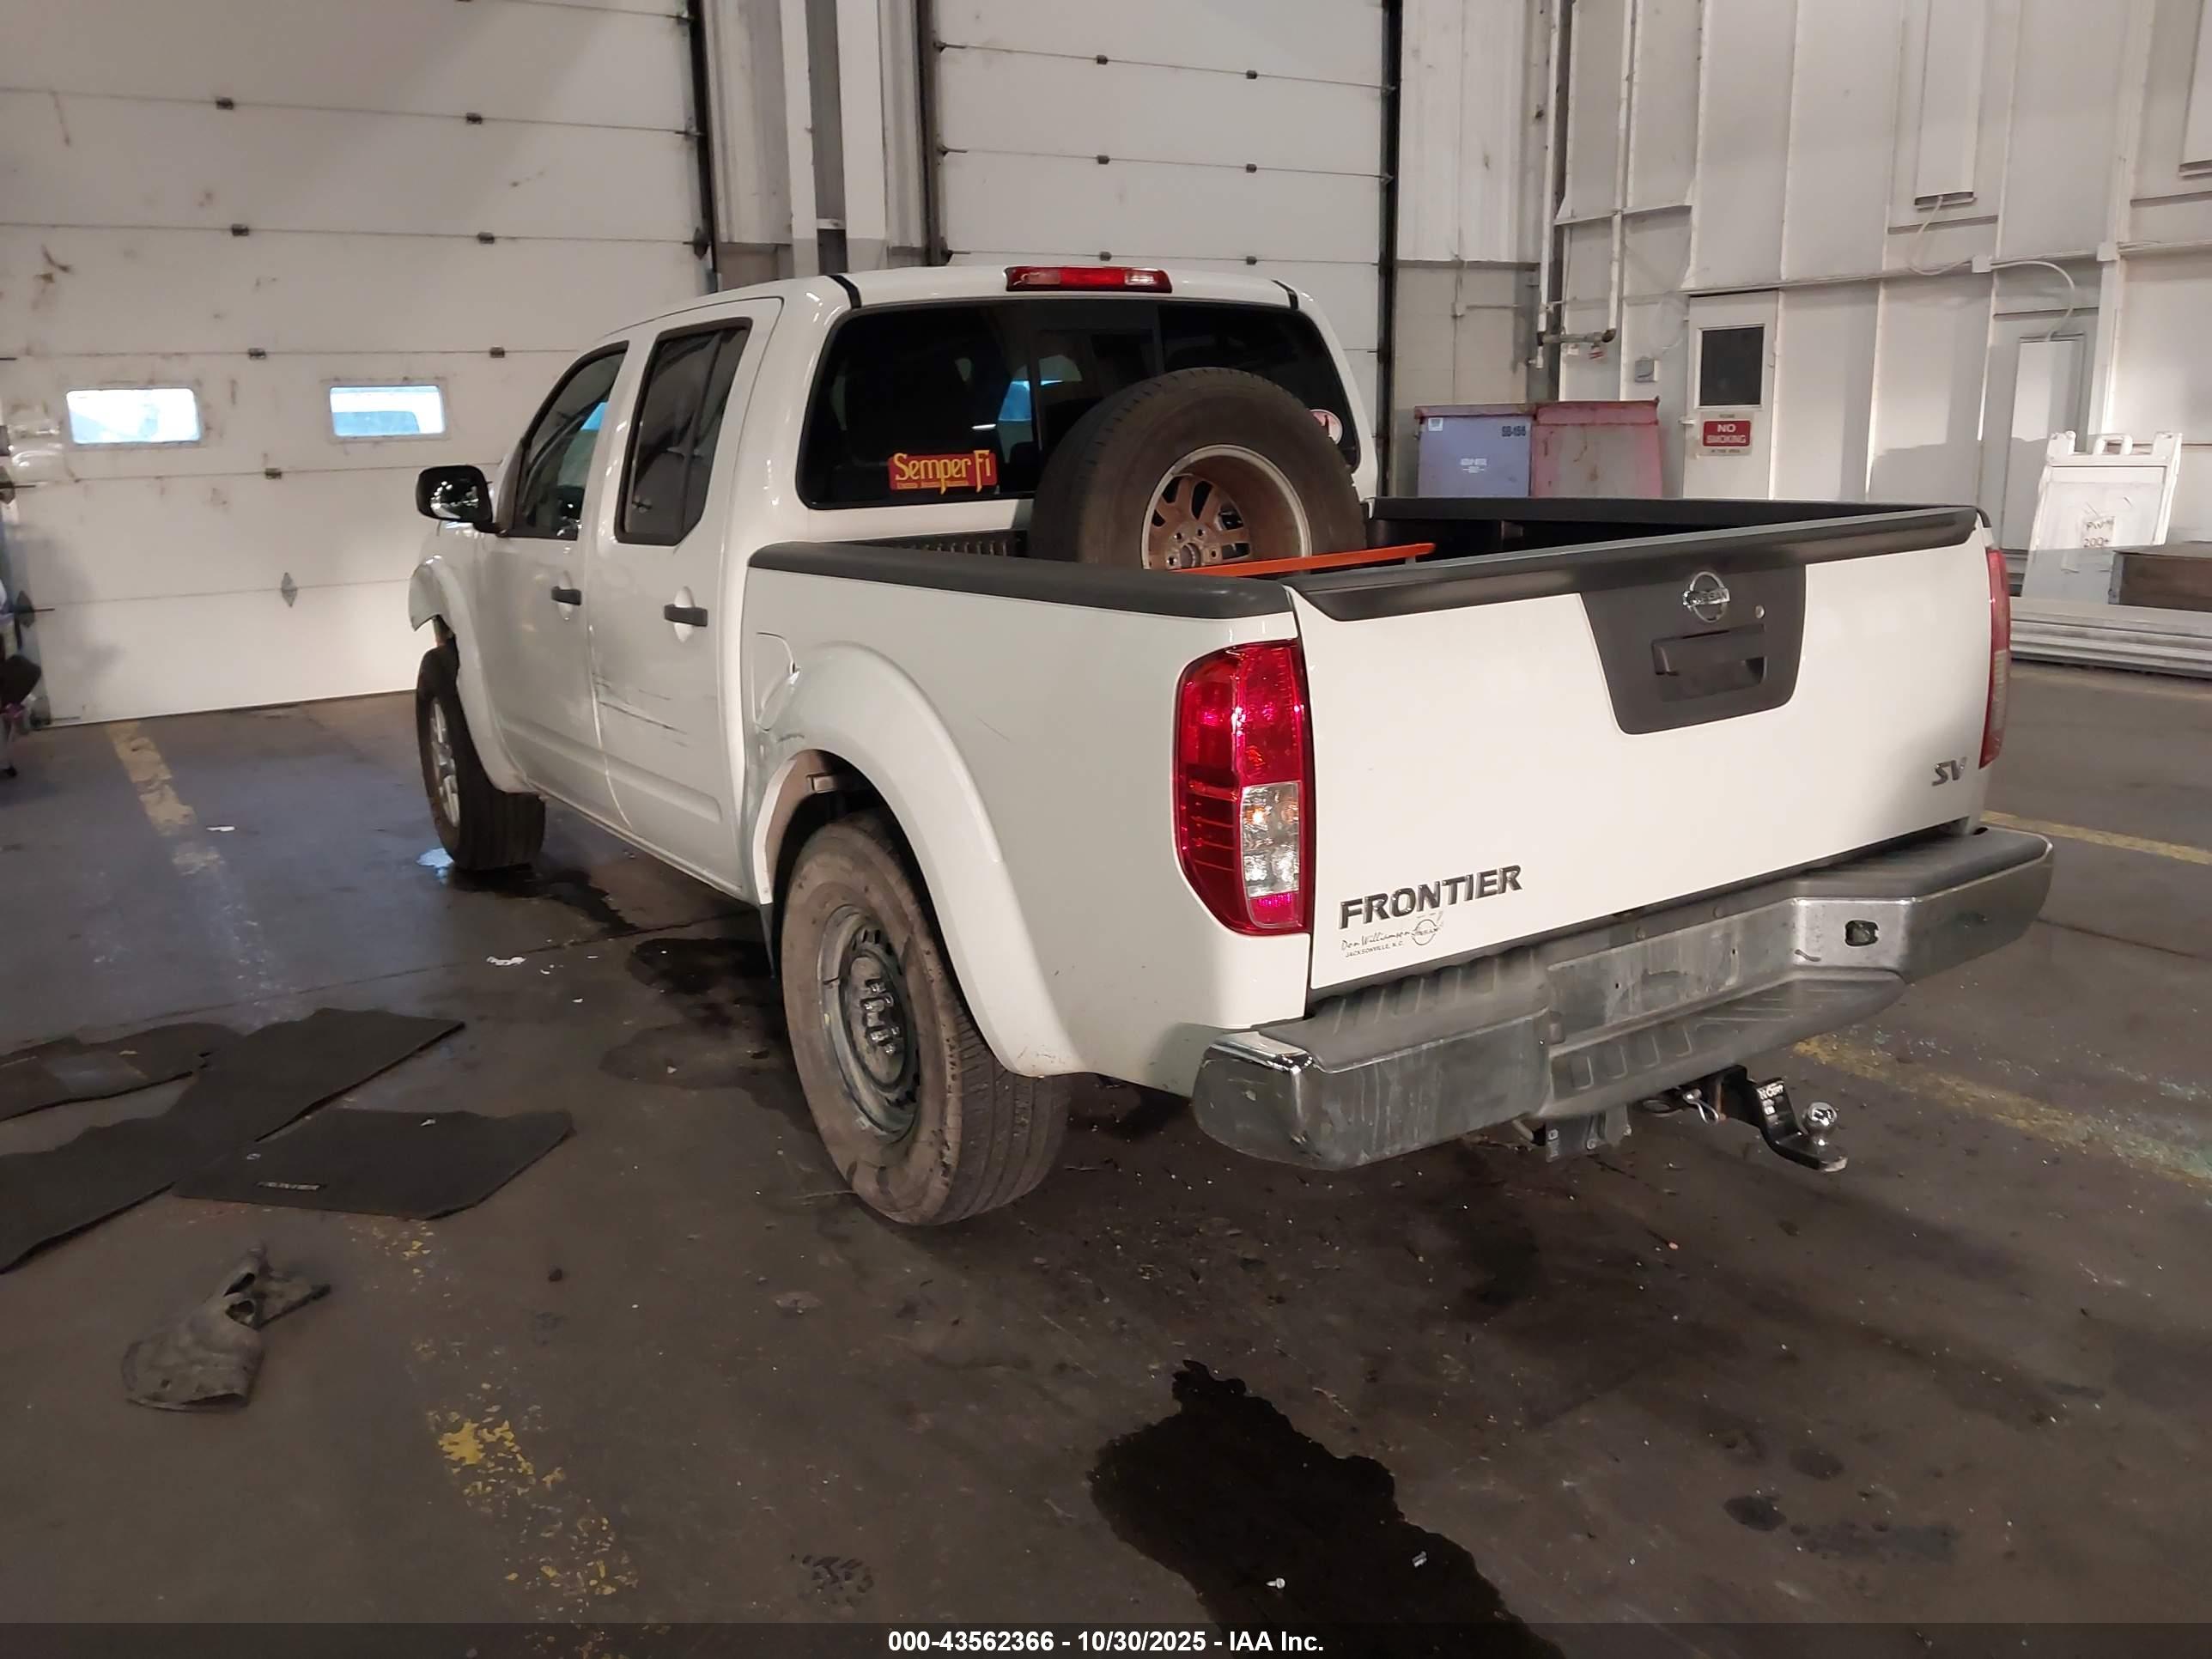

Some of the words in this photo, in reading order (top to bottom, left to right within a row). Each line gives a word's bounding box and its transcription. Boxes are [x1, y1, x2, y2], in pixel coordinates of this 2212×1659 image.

[1717, 423, 1736, 433] NO
[893, 453, 972, 495] Semper
[973, 449, 991, 493] Fi
[1931, 756, 1967, 787] SV
[1338, 864, 1522, 930] FRONTIER
